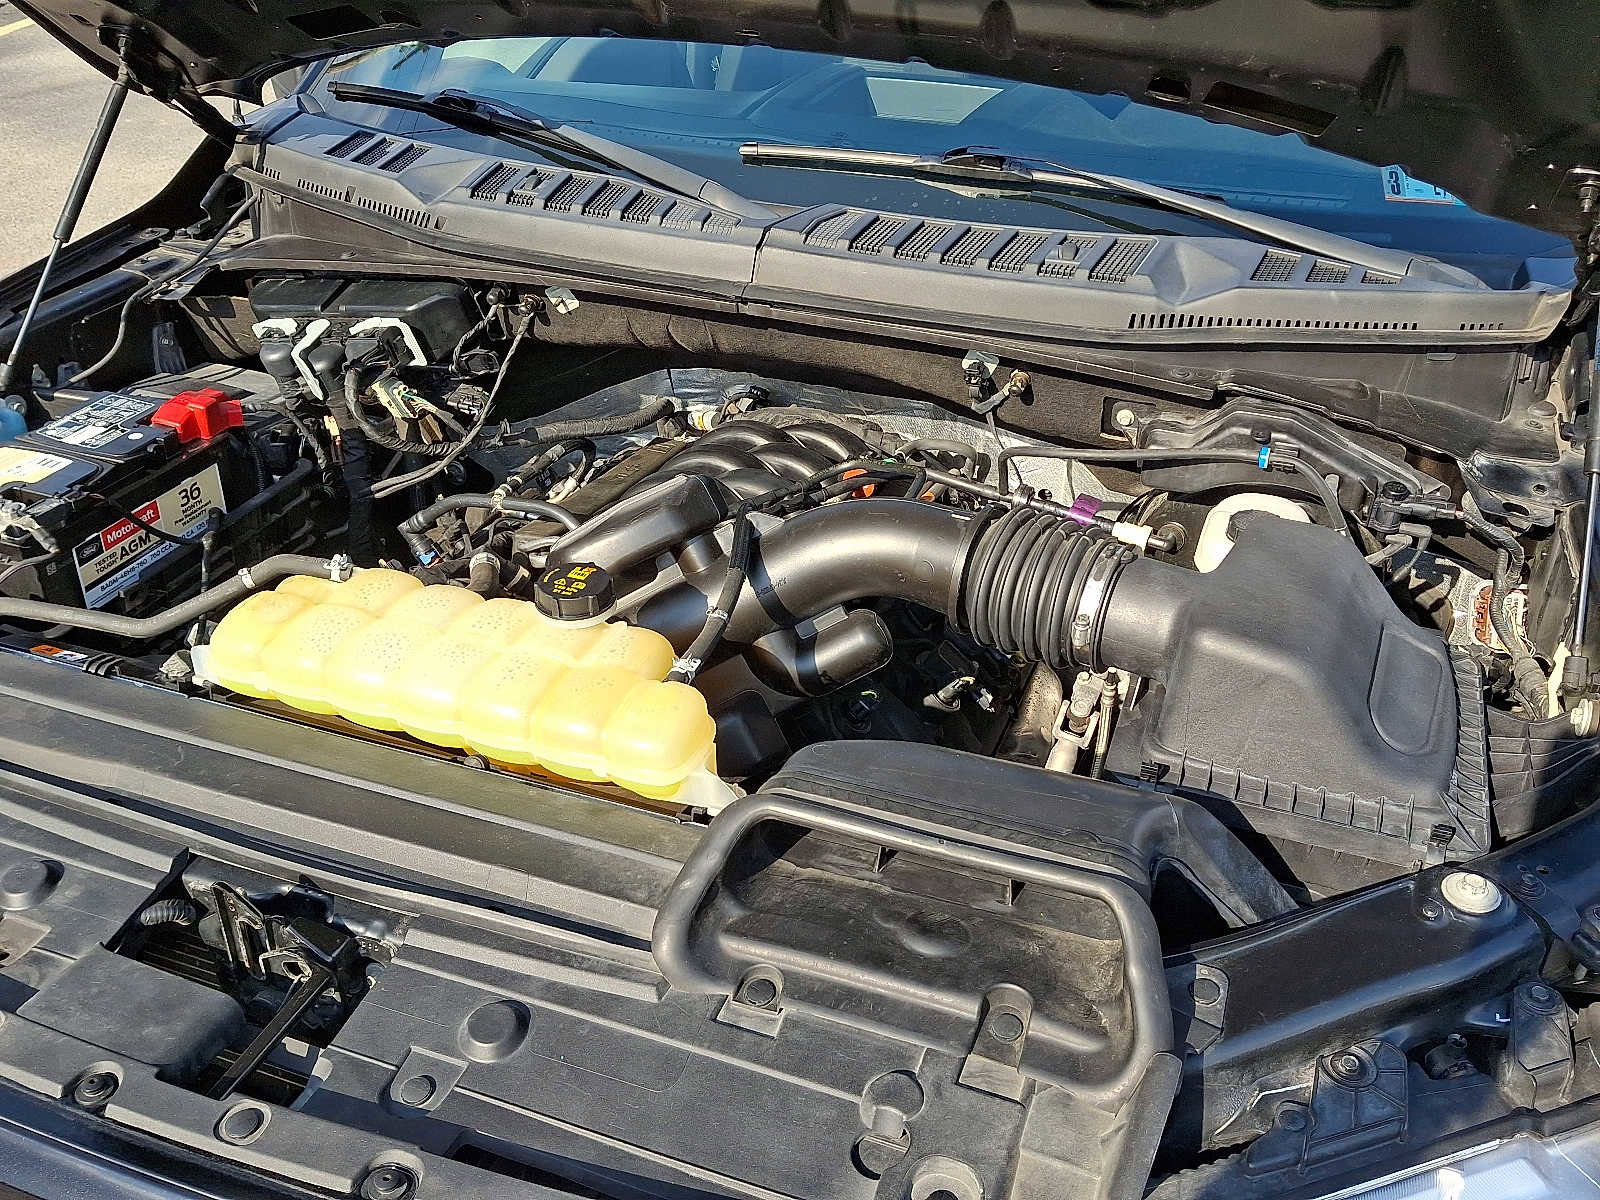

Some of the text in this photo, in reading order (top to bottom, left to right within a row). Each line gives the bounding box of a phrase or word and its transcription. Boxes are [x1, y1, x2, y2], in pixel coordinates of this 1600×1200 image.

[1388, 170, 1401, 196] 3
[178, 482, 201, 508] 36
[182, 499, 203, 515] MONTH
[106, 508, 155, 544] Motoraft
[119, 532, 152, 561] AGM
[160, 542, 174, 554] CCA
[94, 551, 117, 569] TESTED
